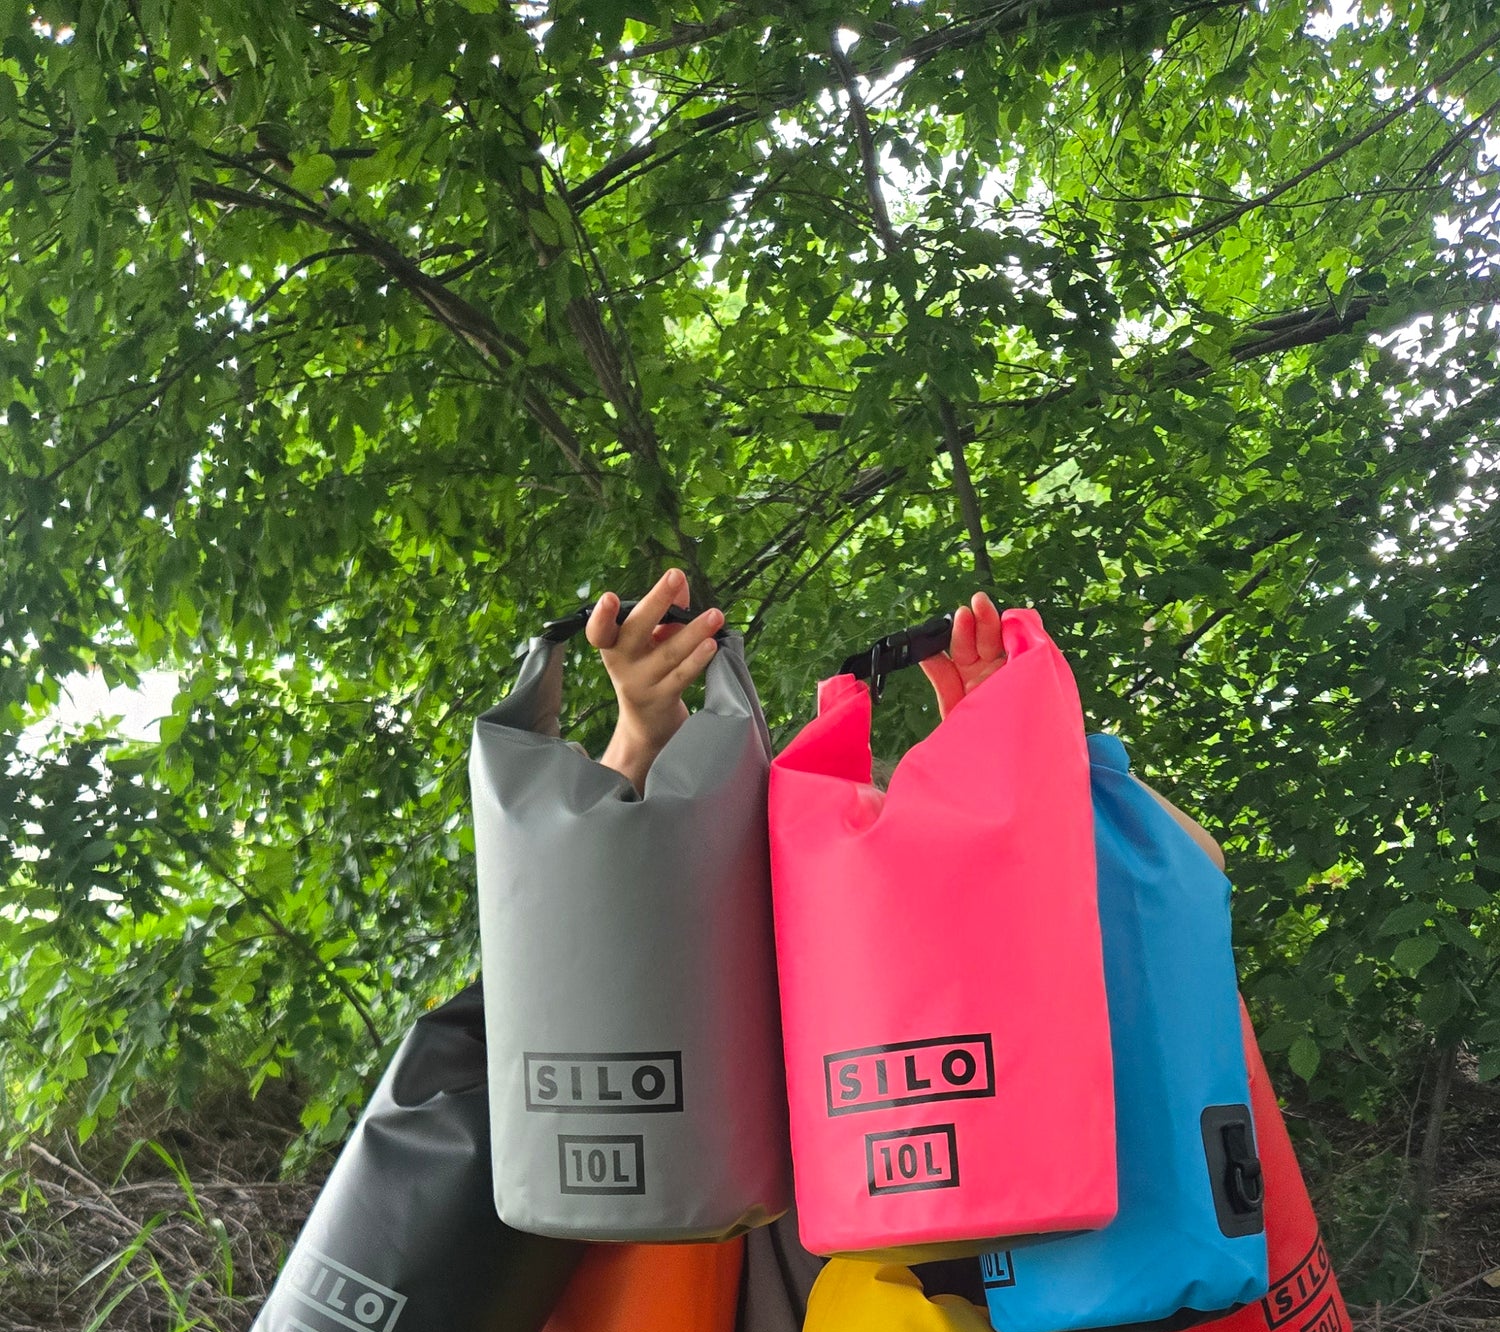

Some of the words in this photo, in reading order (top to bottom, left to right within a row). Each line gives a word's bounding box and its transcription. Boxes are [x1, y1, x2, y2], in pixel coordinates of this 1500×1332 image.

[536, 1064, 666, 1101] SILO
[839, 1048, 977, 1101] SILO
[572, 1149, 630, 1183] 10L
[880, 1141, 943, 1181] 10L
[1275, 1244, 1328, 1315] SILO
